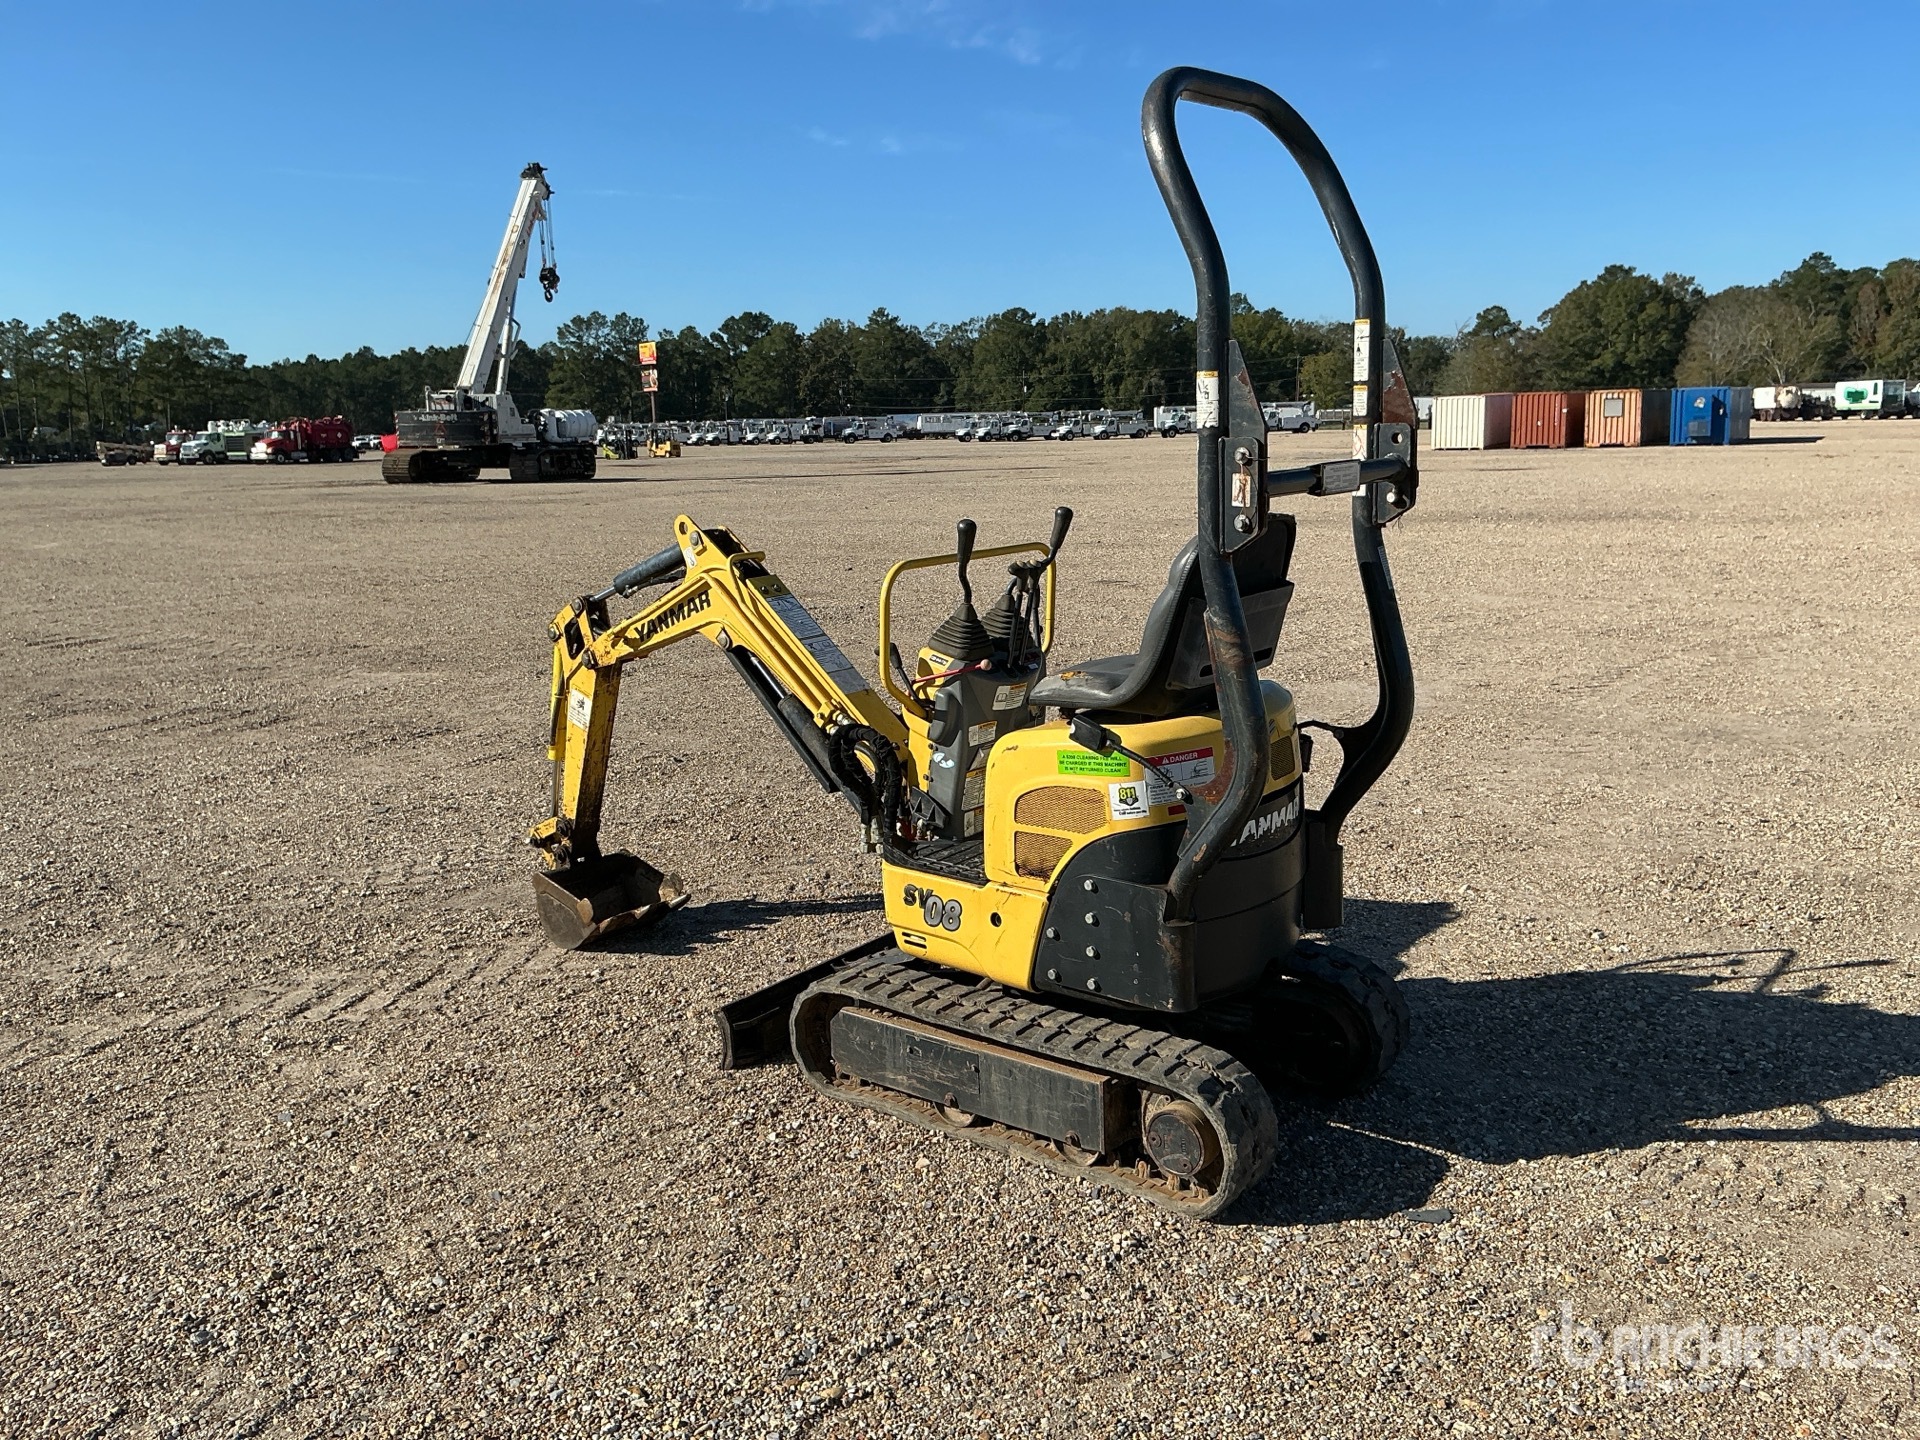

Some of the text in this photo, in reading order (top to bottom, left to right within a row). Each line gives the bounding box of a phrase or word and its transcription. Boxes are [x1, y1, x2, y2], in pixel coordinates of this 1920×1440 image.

[634, 589, 711, 642] YANMAR
[1169, 752, 1198, 763] DANGER
[1119, 787, 1136, 800] 811
[903, 884, 962, 932] SV08
